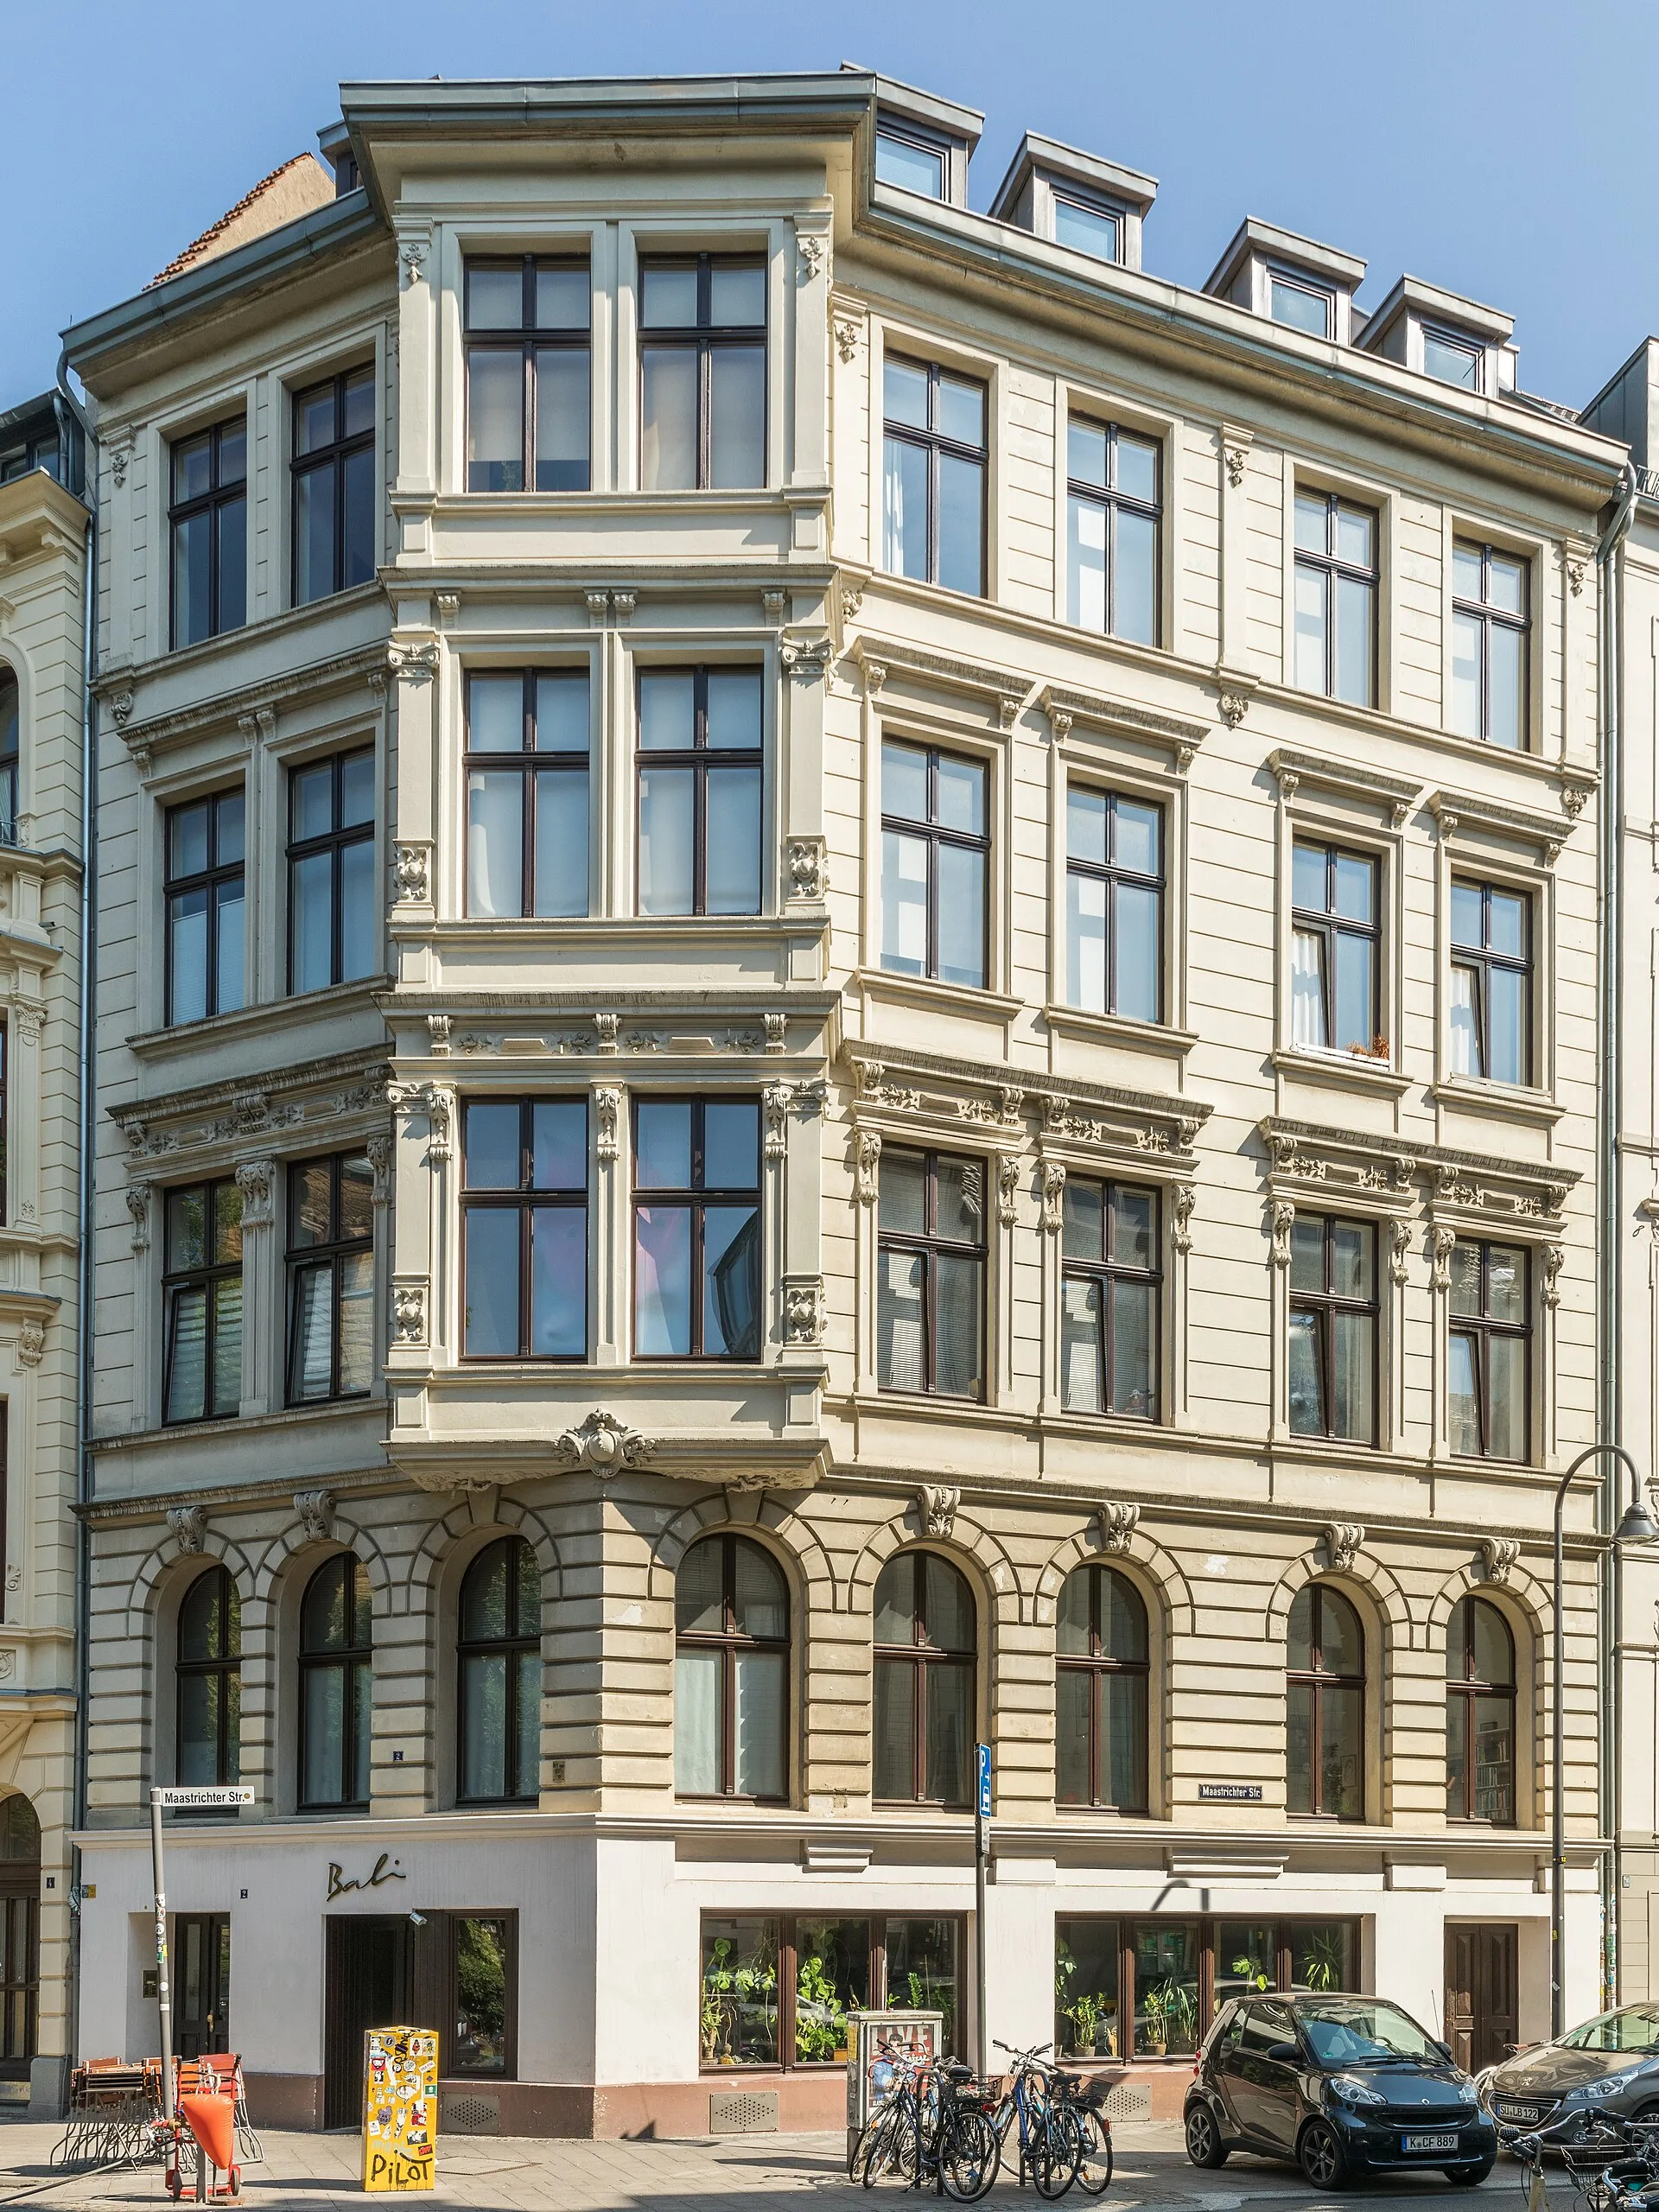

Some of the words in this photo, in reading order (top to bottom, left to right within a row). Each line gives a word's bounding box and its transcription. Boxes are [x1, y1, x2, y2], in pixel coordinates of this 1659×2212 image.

[165, 1792, 226, 1804] Maastrichter
[228, 1791, 245, 1802] Str.
[1202, 1785, 1247, 1797] Maastrichter
[1249, 1787, 1261, 1798] Str.
[326, 1853, 406, 1902] Bali
[1500, 2105, 1510, 2115] SU
[1513, 2107, 1522, 2117] LB
[1523, 2108, 1538, 2120] 122
[1410, 2137, 1417, 2148] K
[1422, 2136, 1435, 2148] CF
[1437, 2136, 1455, 2147] 889
